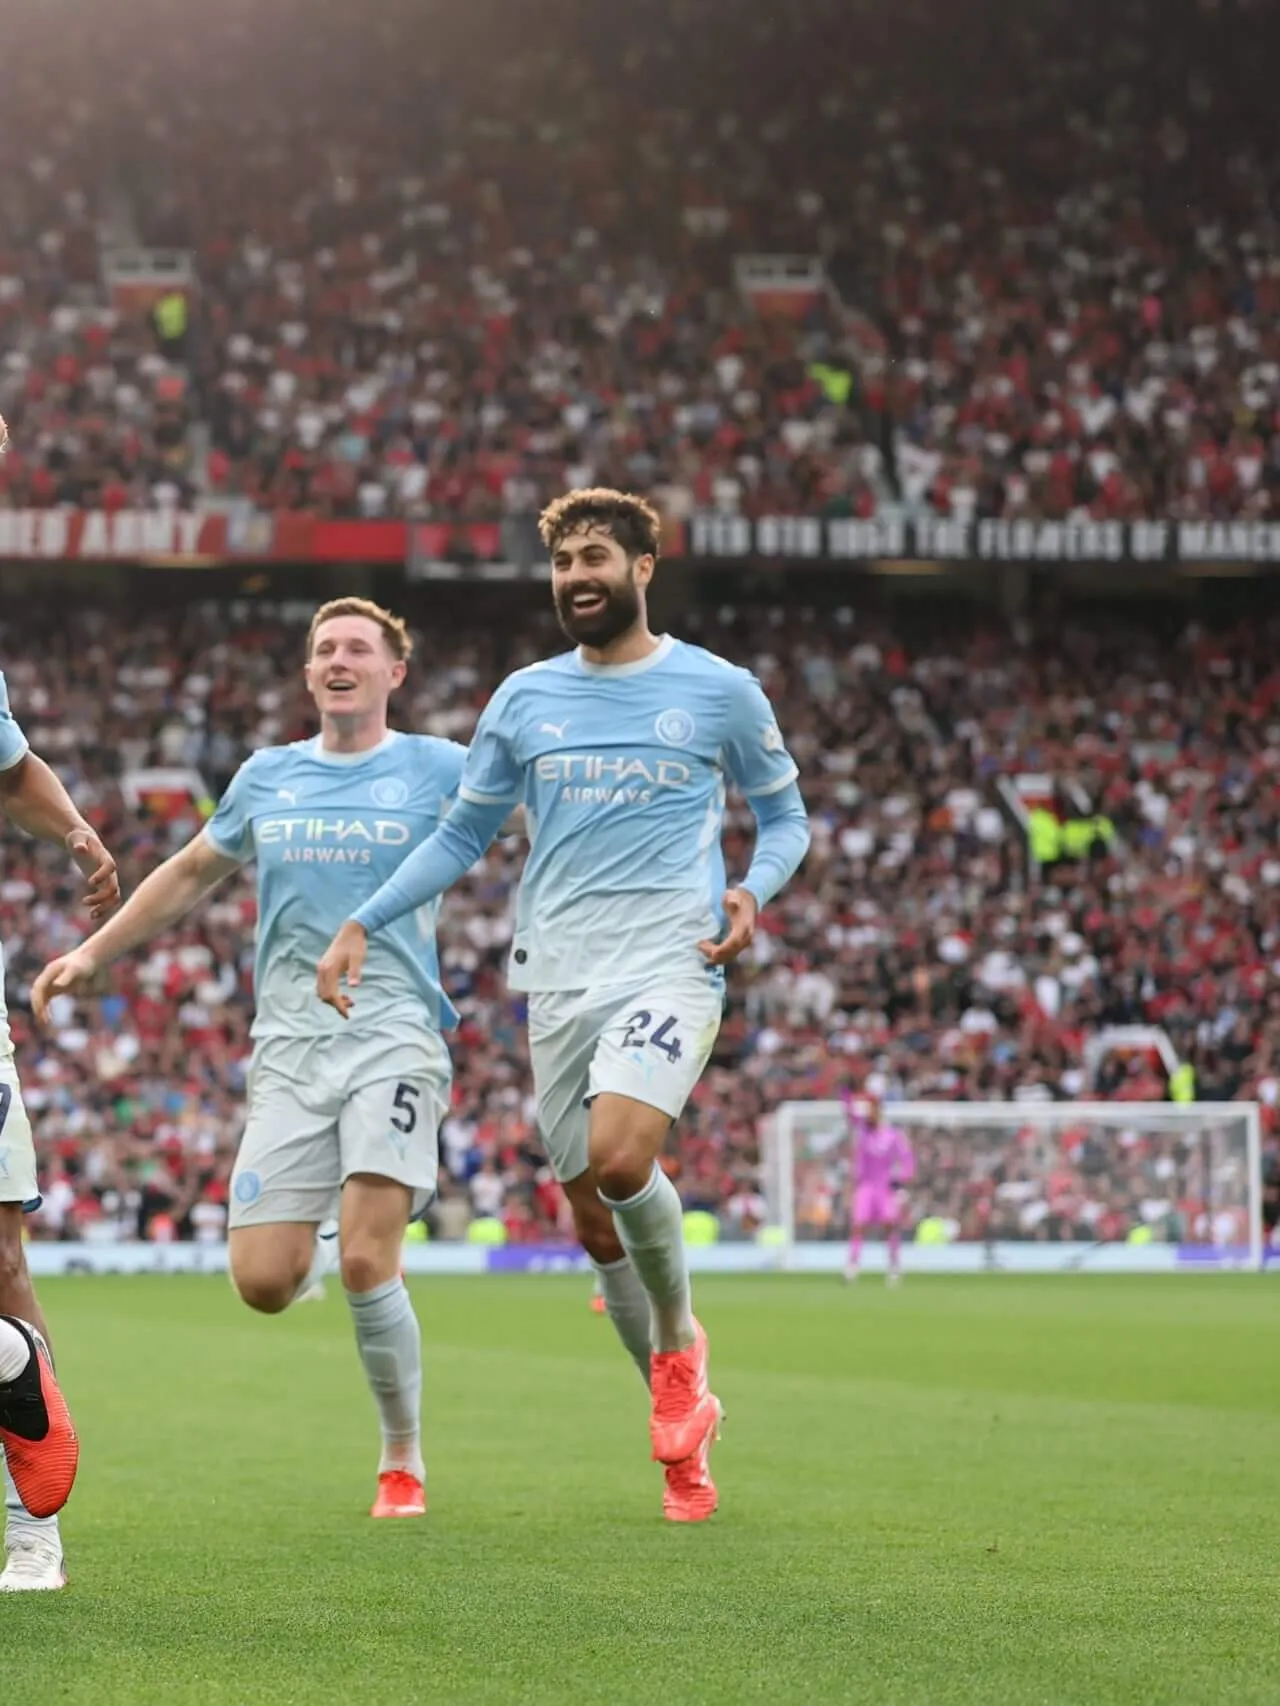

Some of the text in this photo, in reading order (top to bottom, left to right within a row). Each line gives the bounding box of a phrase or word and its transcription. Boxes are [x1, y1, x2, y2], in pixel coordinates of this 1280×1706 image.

[535, 754, 690, 786] ETIHAD
[561, 786, 651, 805] AIRWAYS
[258, 818, 410, 846] ETIHAD
[282, 848, 372, 865] AIRWAYS
[620, 1010, 683, 1064] 24
[389, 1081, 420, 1134] 5
